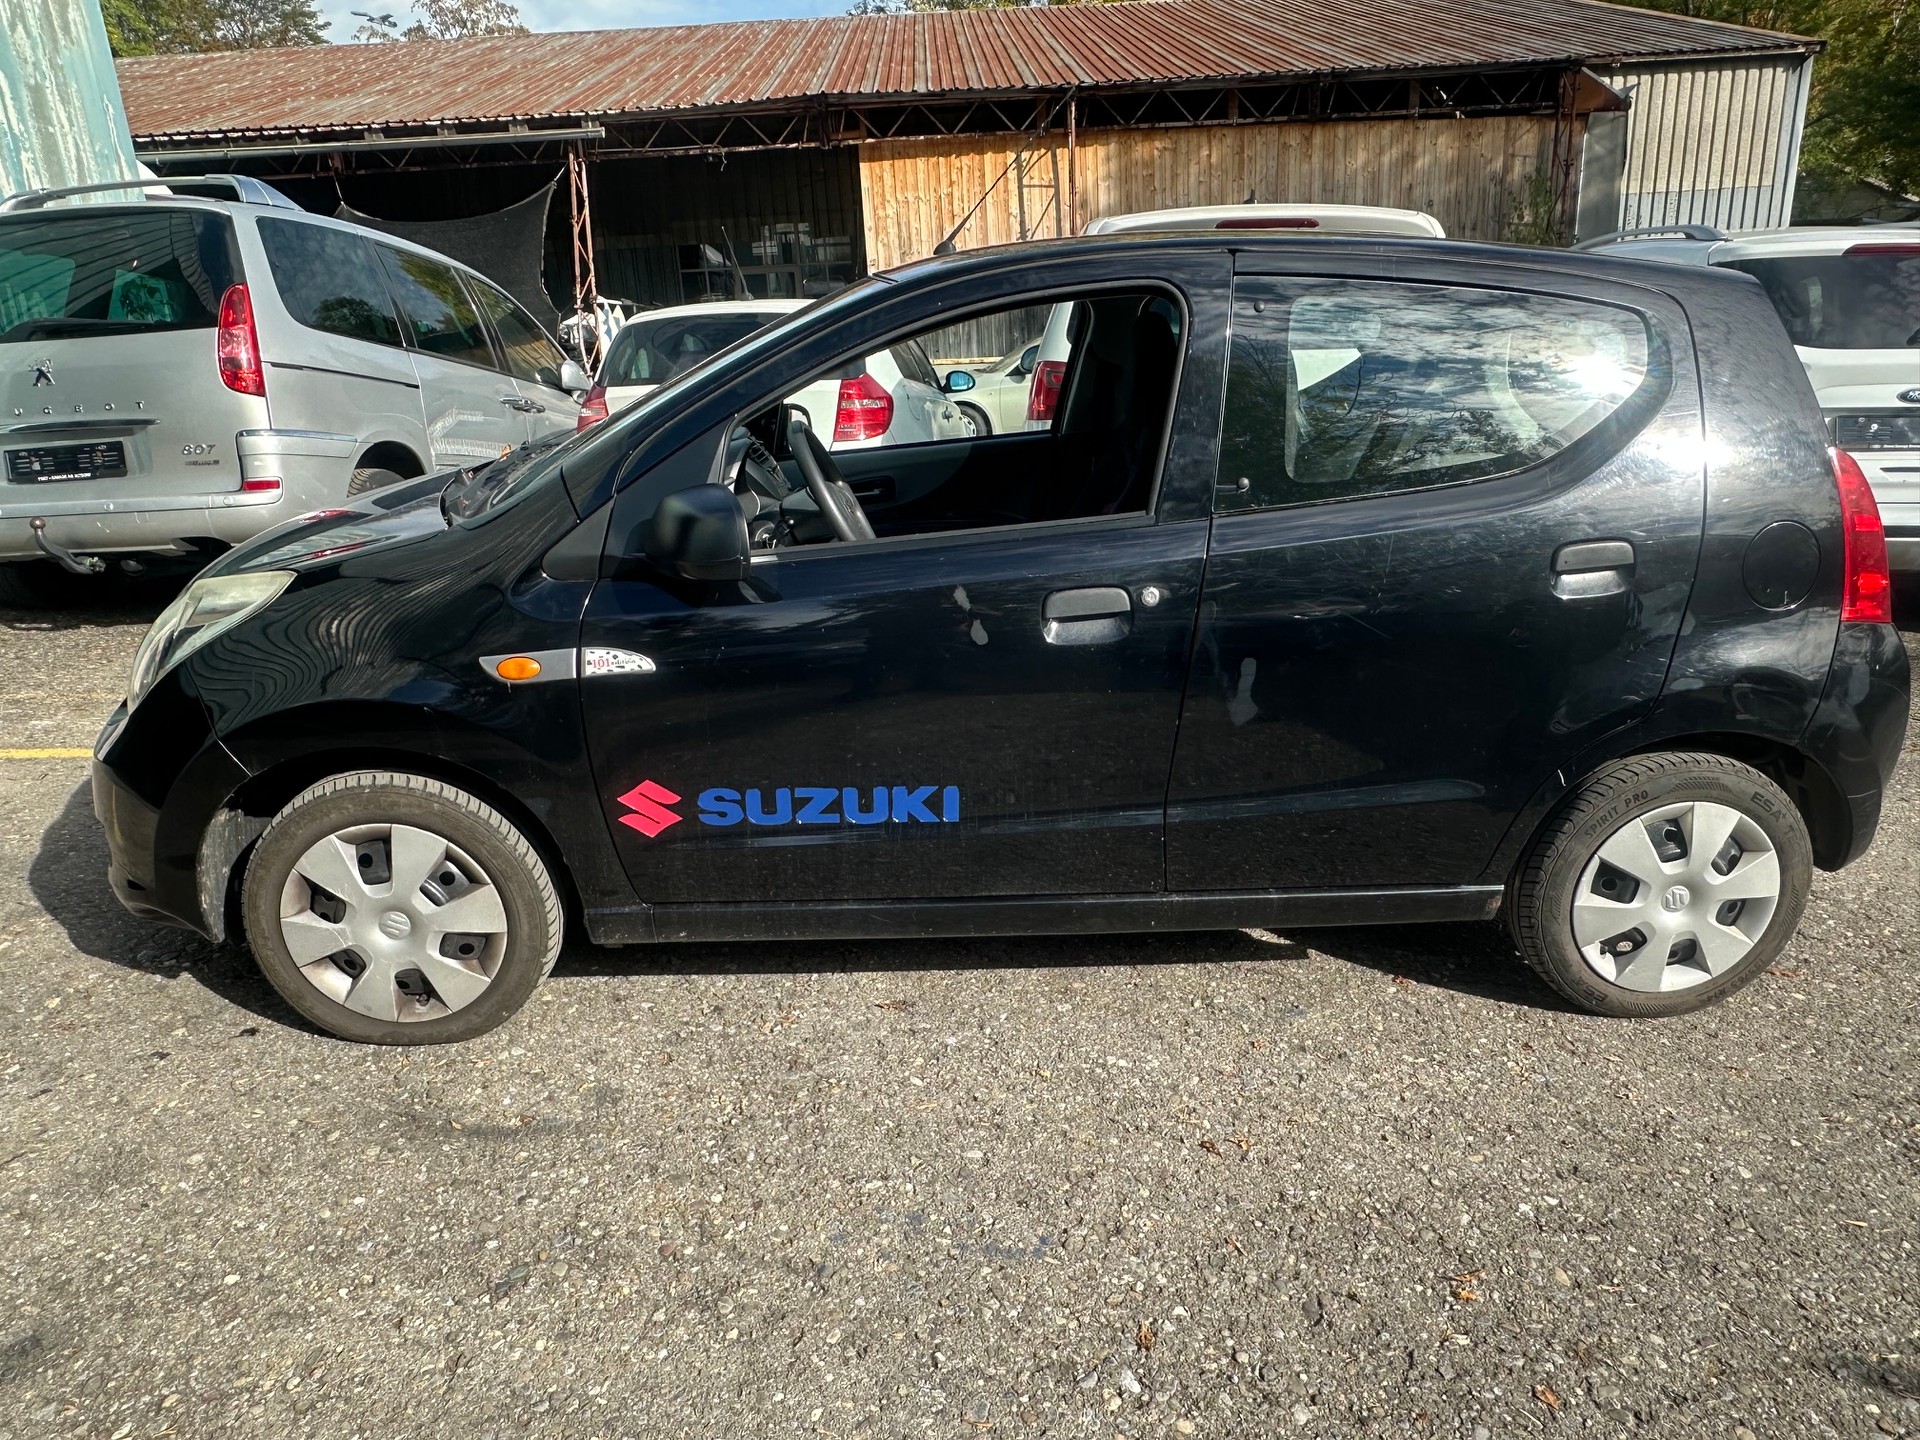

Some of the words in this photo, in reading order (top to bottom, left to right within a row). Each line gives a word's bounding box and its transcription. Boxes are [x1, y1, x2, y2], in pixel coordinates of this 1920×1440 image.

[182, 443, 216, 456] 807
[592, 658, 610, 668] 101
[697, 785, 960, 826] SUZUKI
[1583, 804, 1619, 839] SPIRIT
[1624, 790, 1649, 808] PRO
